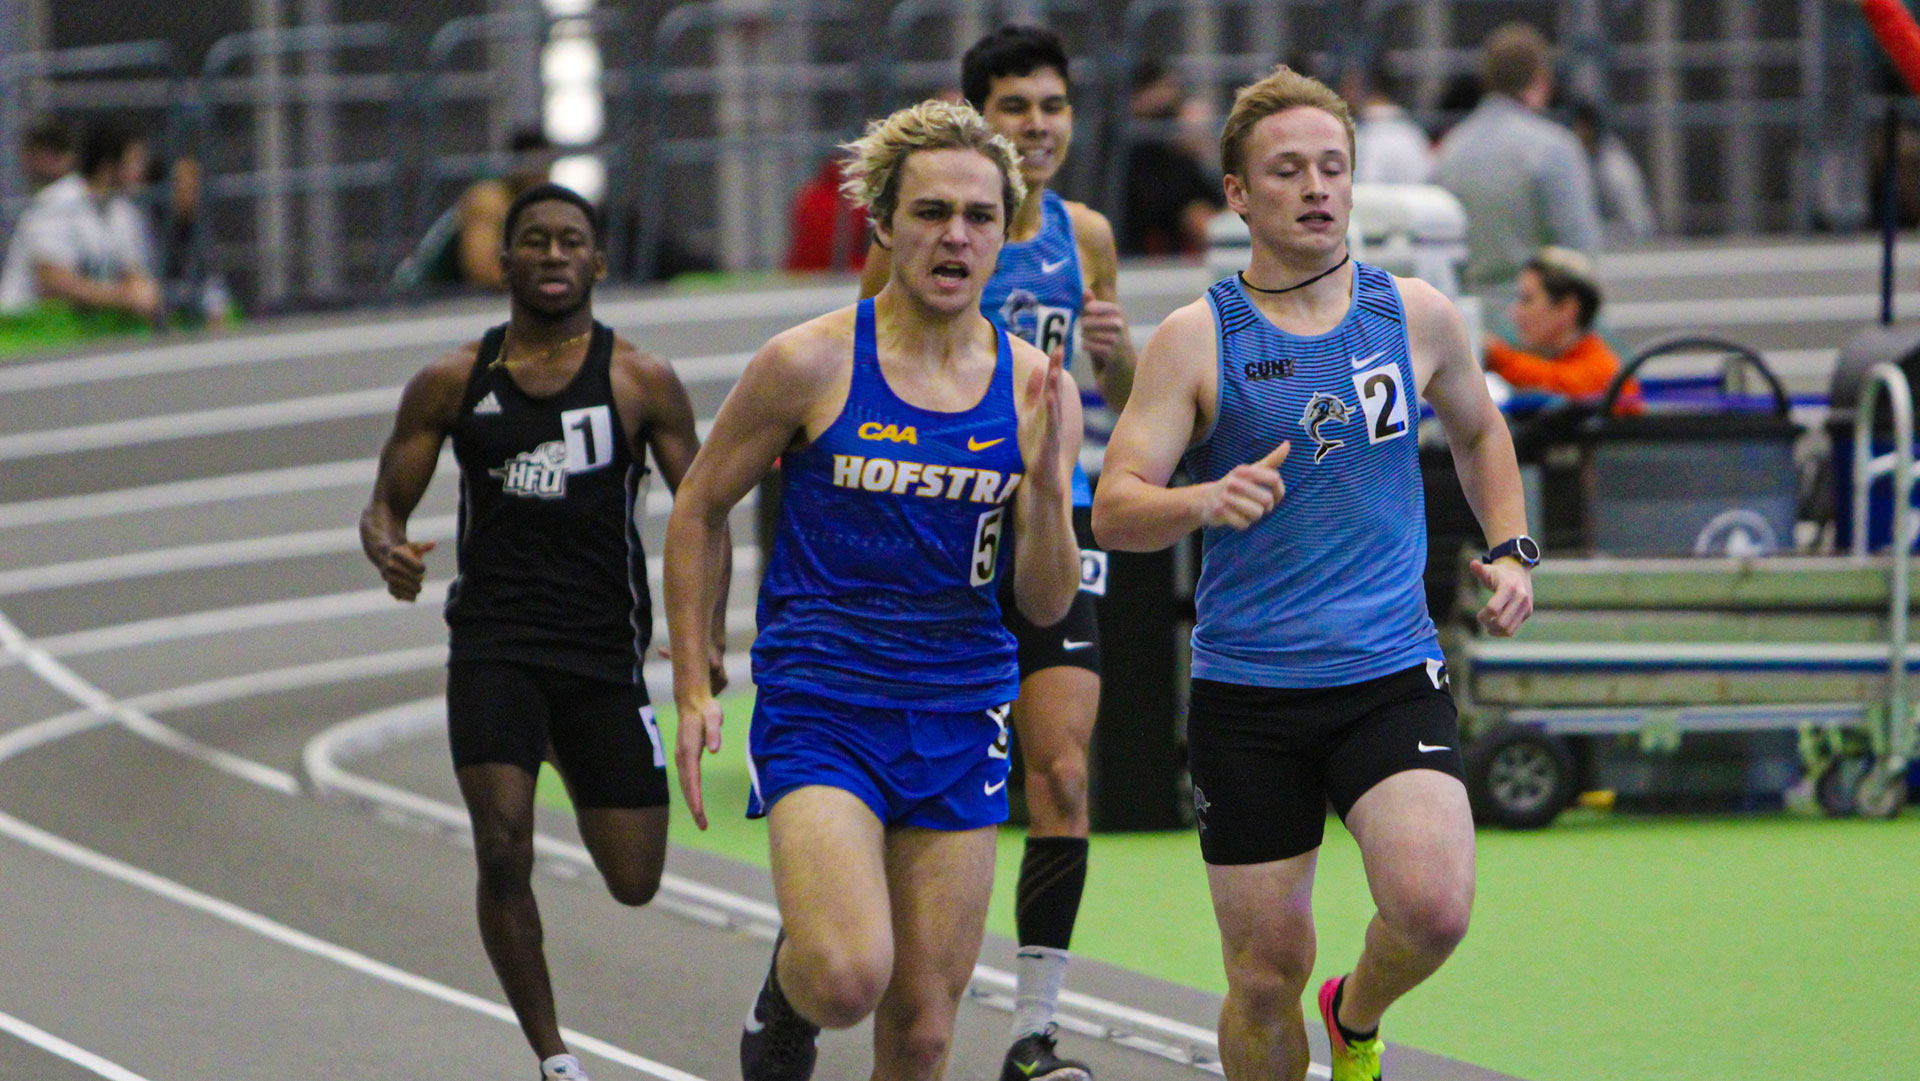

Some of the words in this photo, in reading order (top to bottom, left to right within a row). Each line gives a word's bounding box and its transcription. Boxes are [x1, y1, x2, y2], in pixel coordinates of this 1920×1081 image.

[1042, 312, 1065, 354] 6
[1363, 373, 1406, 439] 2
[570, 415, 596, 465] 1
[857, 421, 918, 445] CAA
[505, 461, 565, 495] HFU
[976, 512, 999, 580] 5
